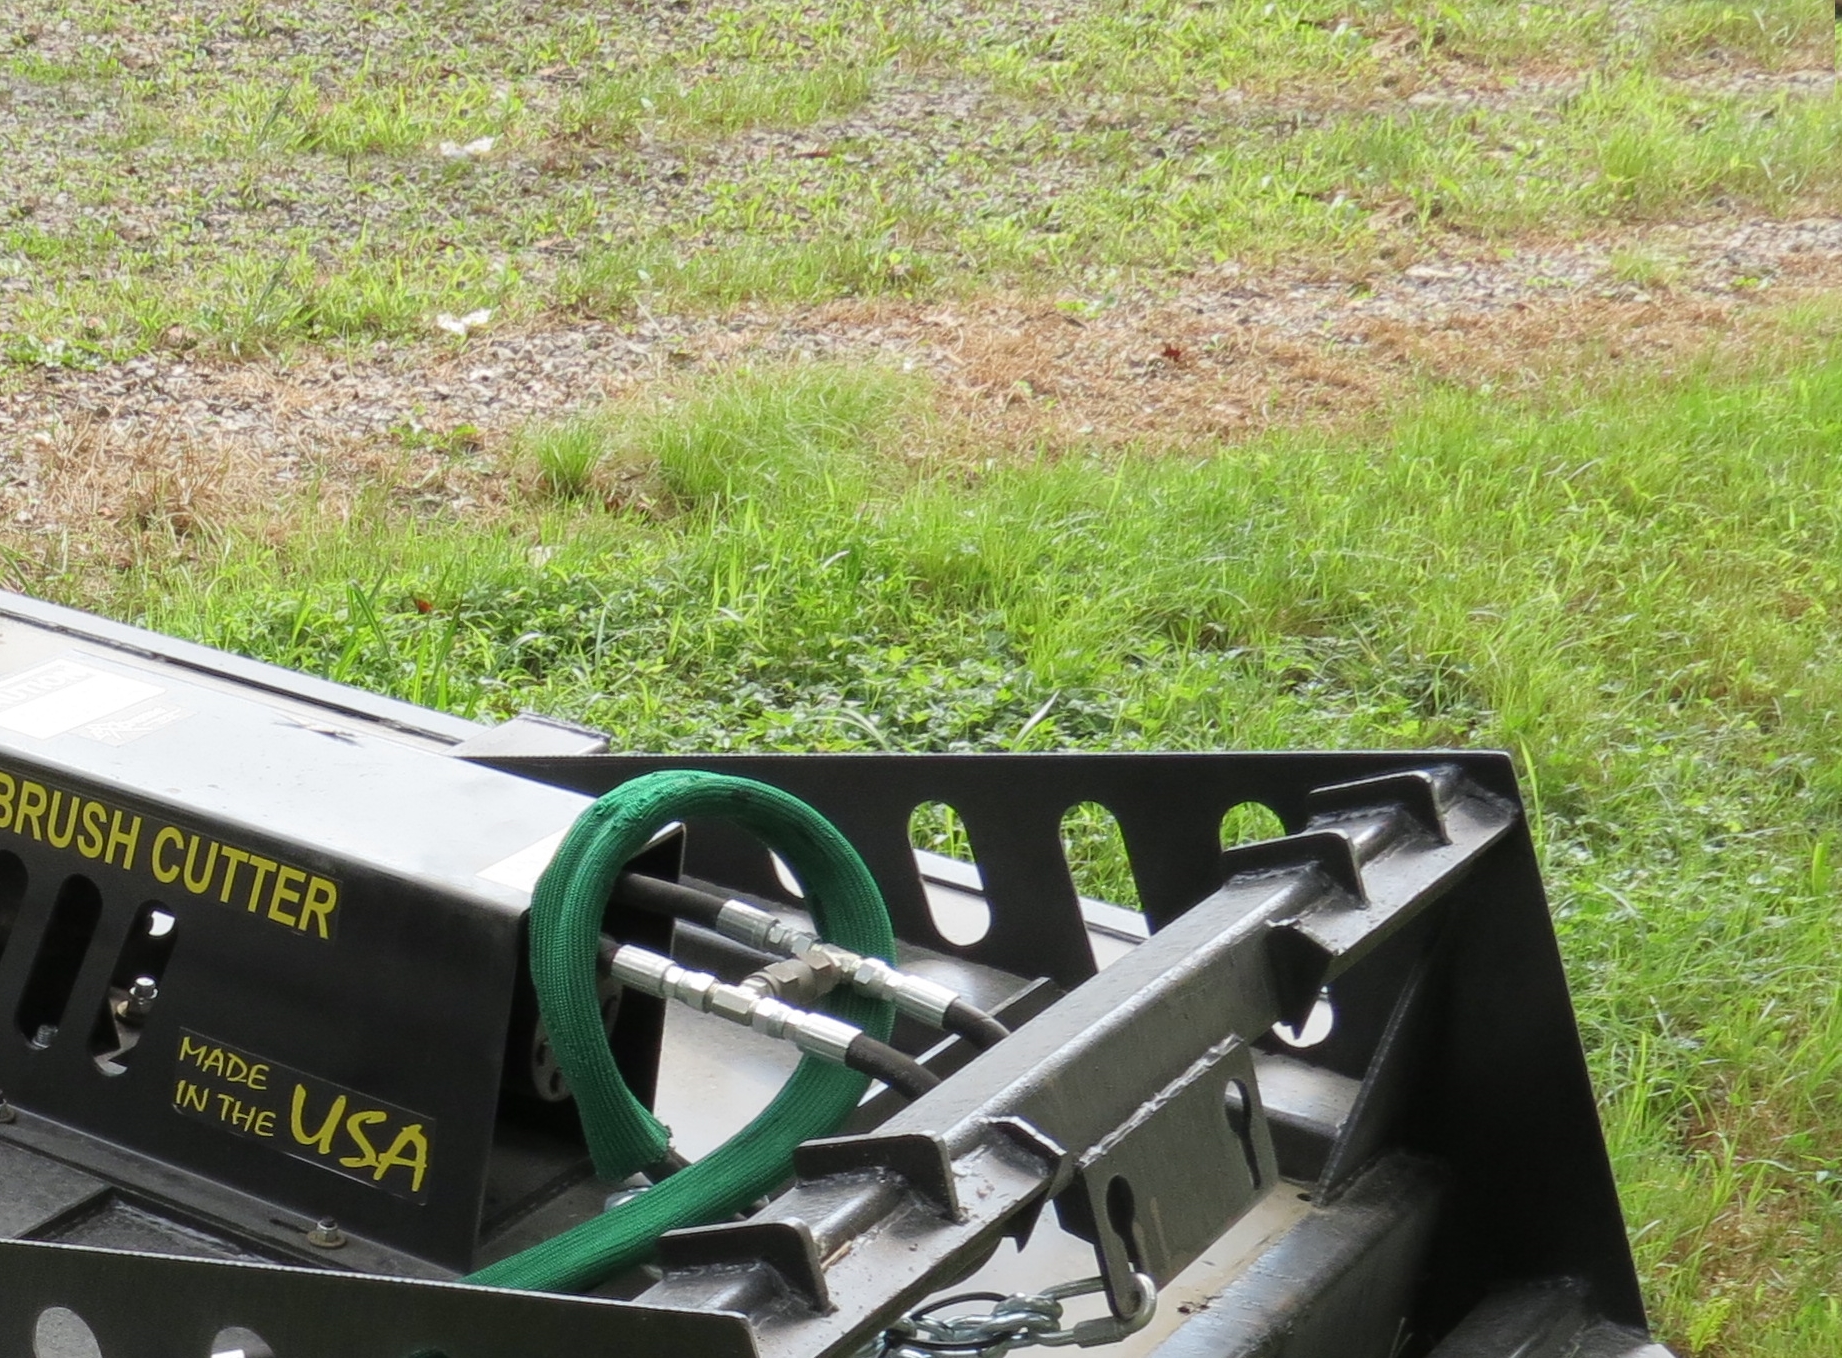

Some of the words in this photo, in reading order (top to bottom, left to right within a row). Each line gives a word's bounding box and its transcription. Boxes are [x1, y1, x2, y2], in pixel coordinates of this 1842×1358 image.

[151, 826, 338, 939] CUTTER
[179, 1036, 270, 1090] MADE
[176, 1079, 209, 1112] IN
[217, 1093, 277, 1137] THE
[290, 1083, 428, 1192] USA
